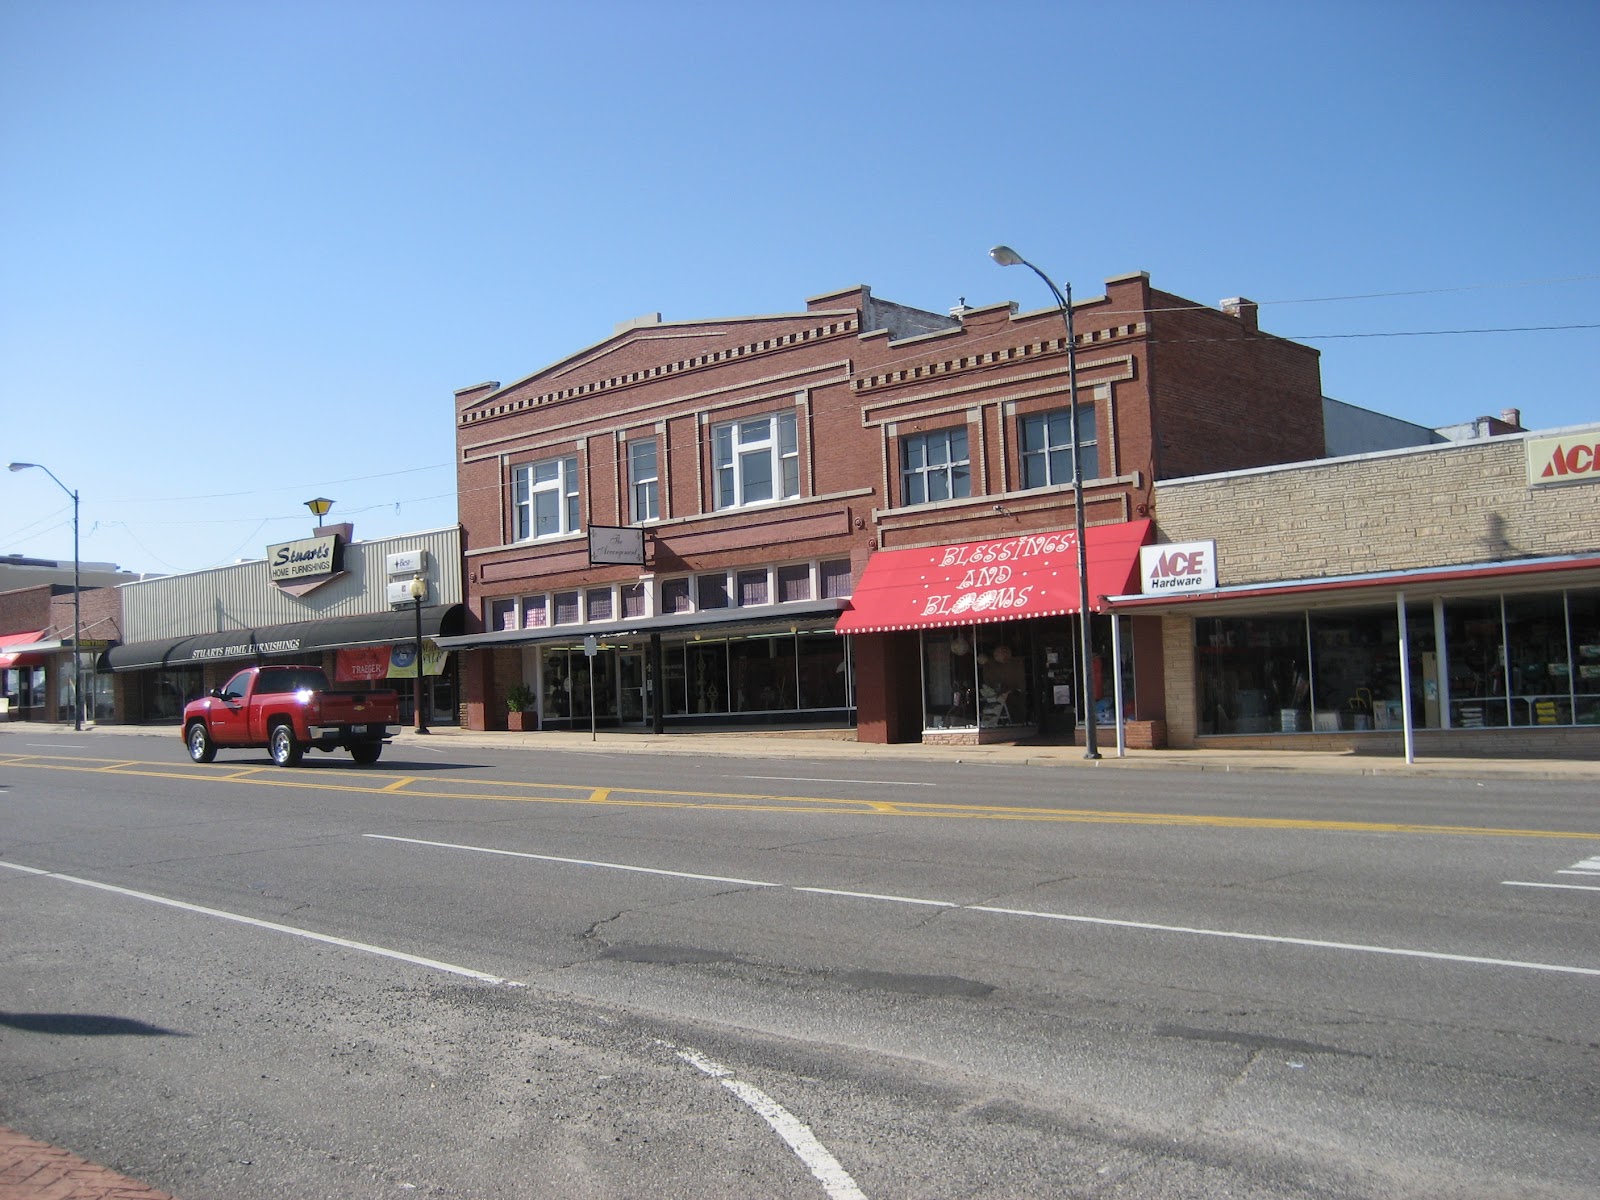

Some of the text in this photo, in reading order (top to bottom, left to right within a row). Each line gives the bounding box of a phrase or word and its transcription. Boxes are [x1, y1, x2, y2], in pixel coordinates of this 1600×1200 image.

[273, 543, 330, 566] Stuart's
[938, 532, 1075, 567] BLESSINGS
[273, 561, 330, 578] HOME FURNISHINGS
[1150, 549, 1204, 578] ACE
[956, 565, 1012, 590] AND
[1152, 577, 1202, 589] Hardware
[920, 585, 1034, 616] BLOOMS
[192, 639, 301, 660] STUARTS HOME FURNISHINGS
[352, 664, 381, 674] TRAEGER
